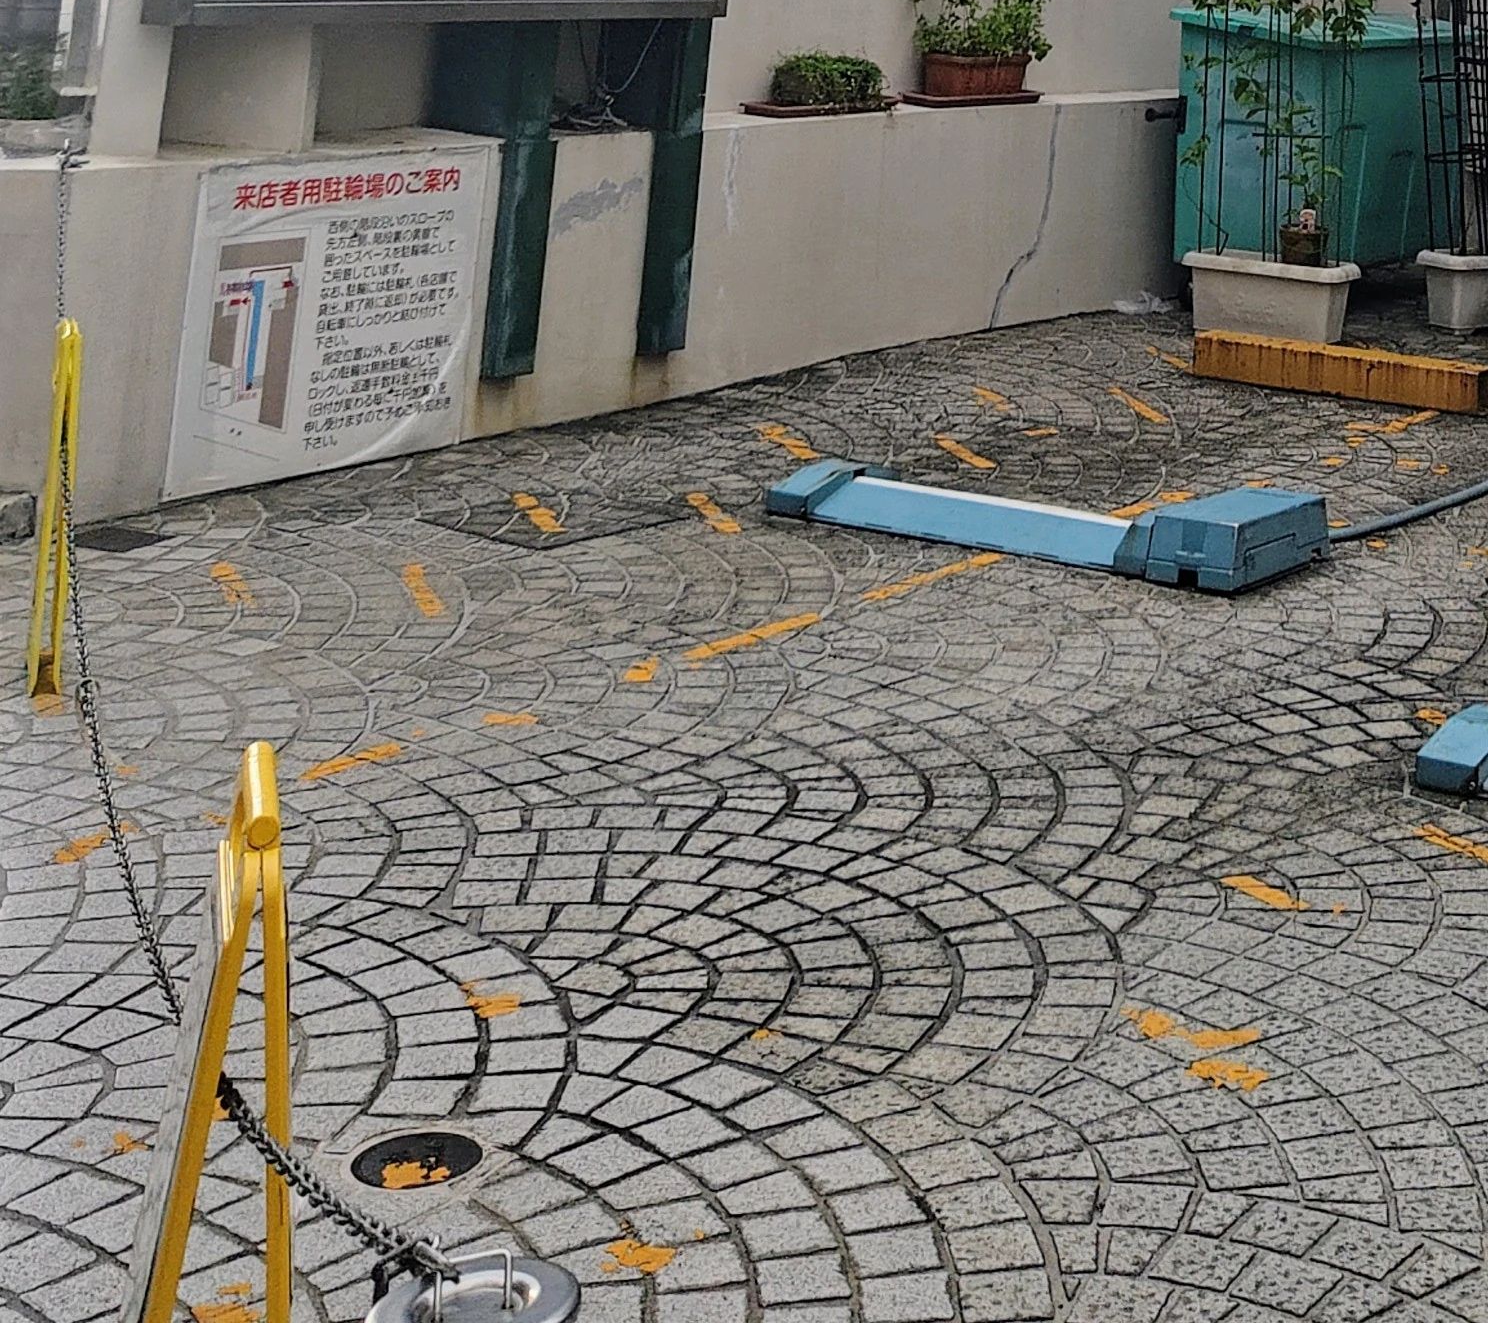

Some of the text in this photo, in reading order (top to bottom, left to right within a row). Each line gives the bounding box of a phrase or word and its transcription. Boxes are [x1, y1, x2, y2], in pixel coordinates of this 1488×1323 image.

[232, 166, 461, 211] 来店者用駐輪場のご案内
